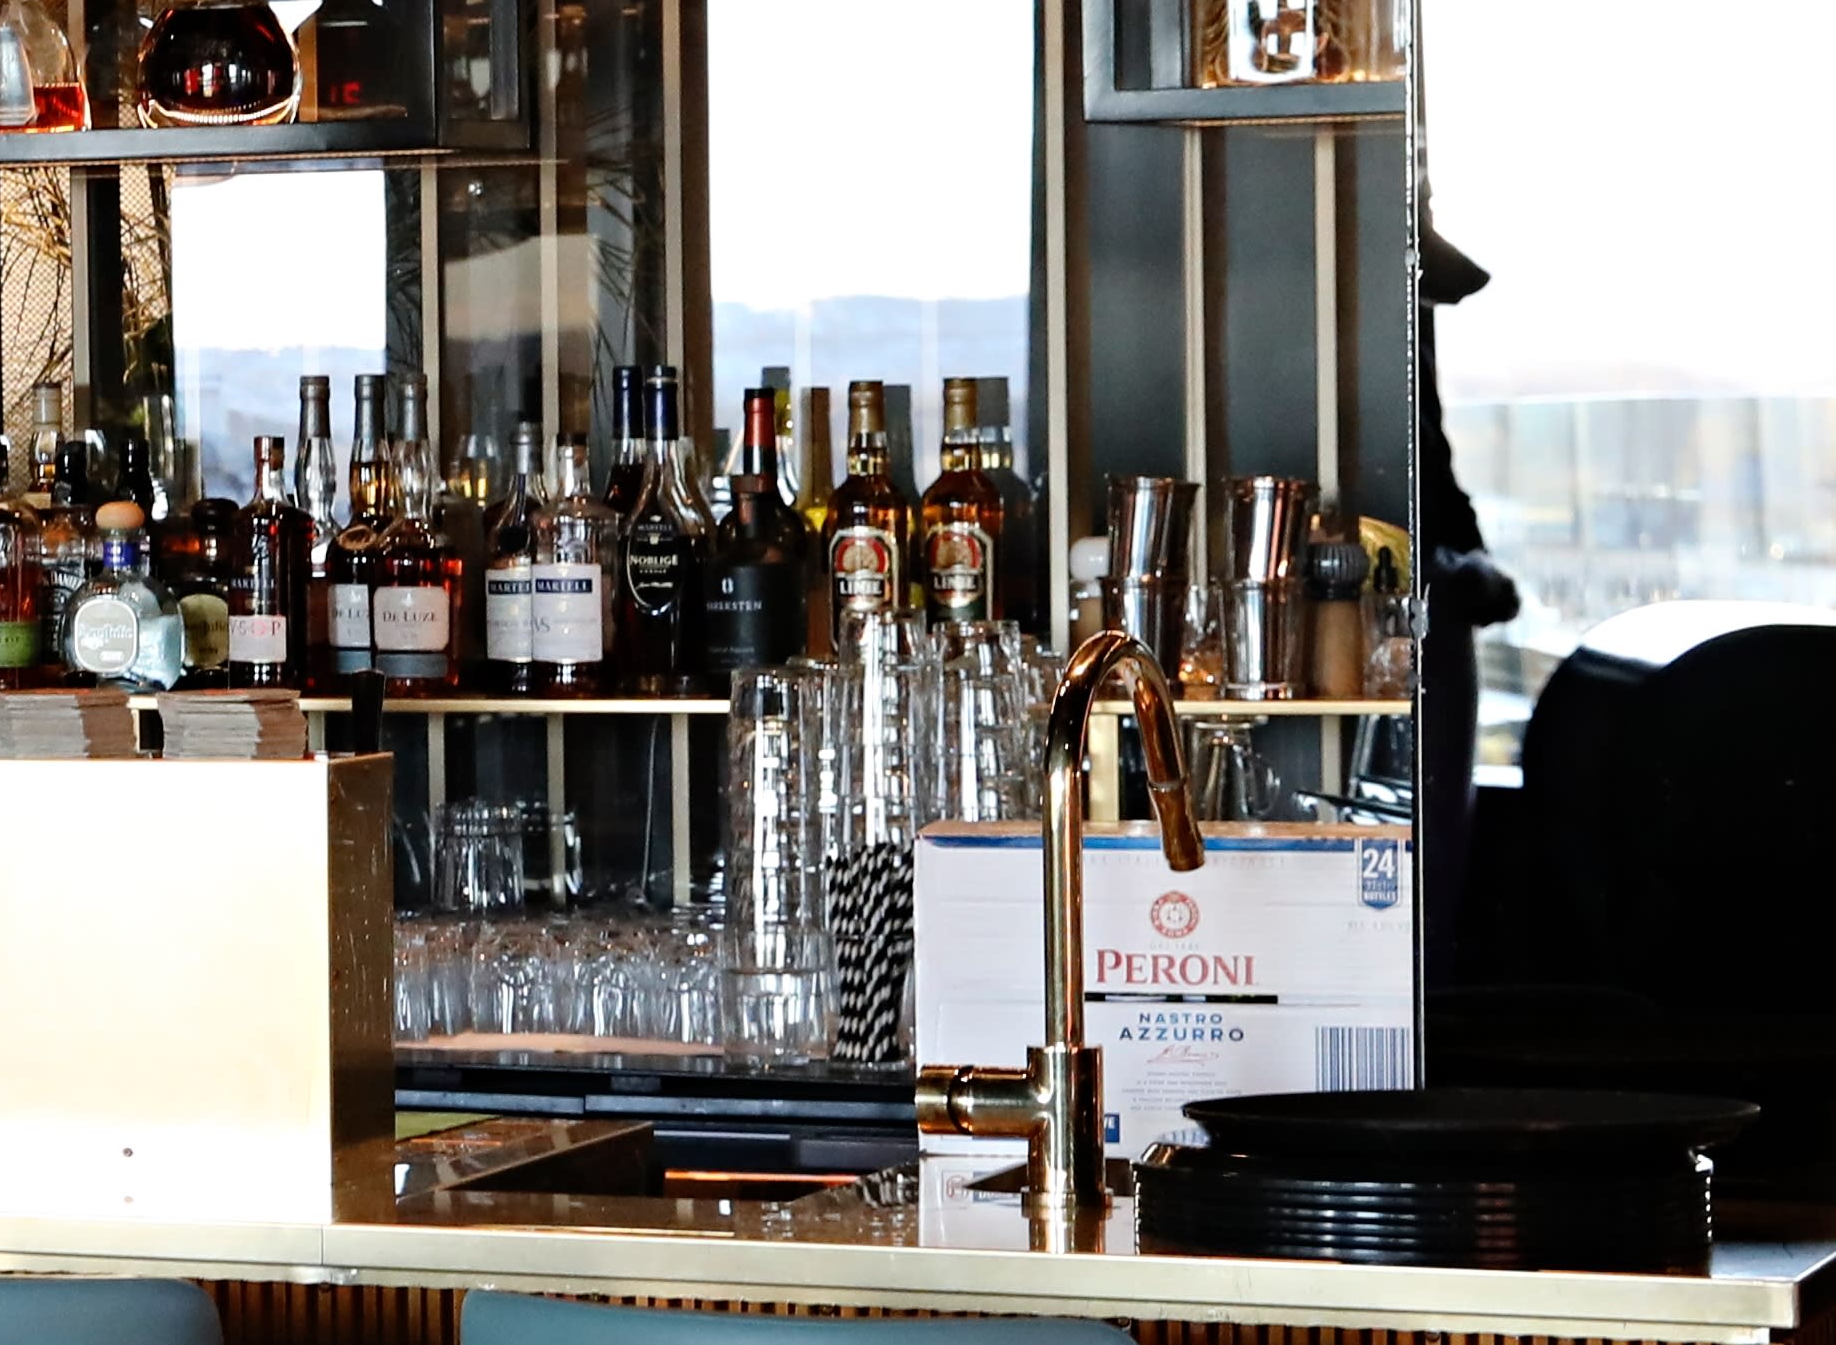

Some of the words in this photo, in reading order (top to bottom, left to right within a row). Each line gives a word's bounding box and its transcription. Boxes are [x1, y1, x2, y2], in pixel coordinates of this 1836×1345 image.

[629, 554, 678, 566] NOBLIGE
[490, 582, 531, 592] MARTEL
[839, 579, 883, 595] LINIE
[1363, 848, 1396, 879] 24
[1095, 948, 1255, 986] PERONI
[1139, 1012, 1223, 1025] NASTRO
[1118, 1027, 1245, 1042] AZZURRO
